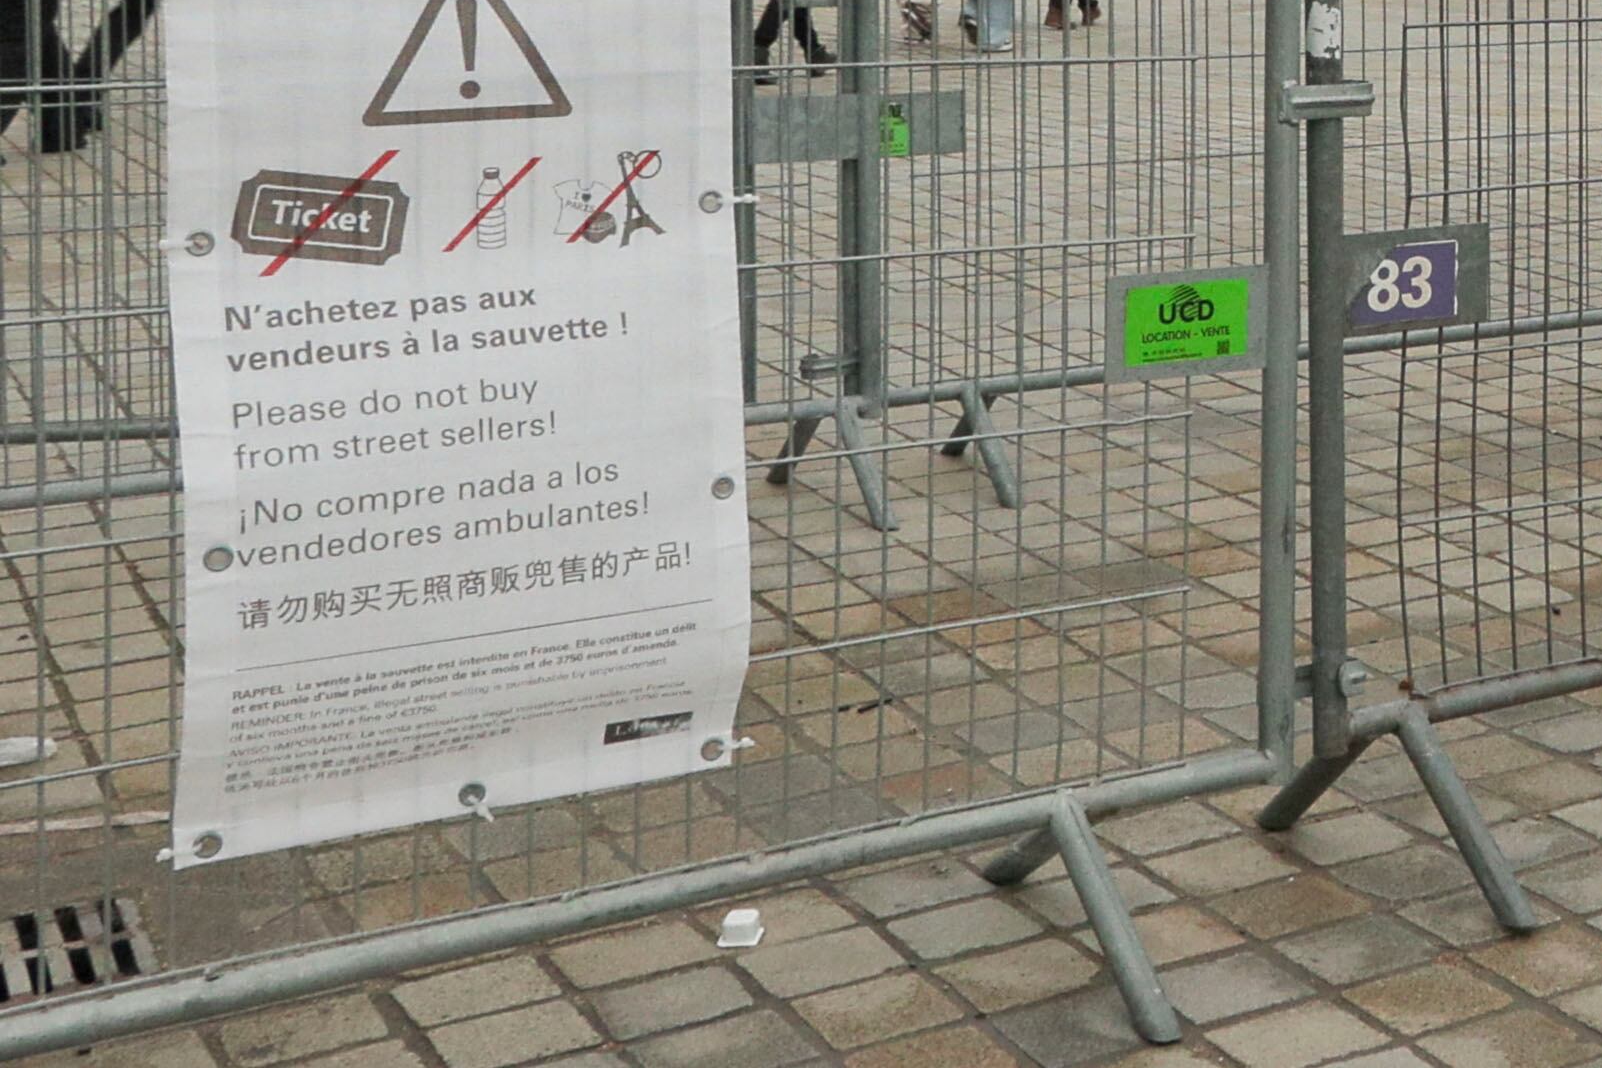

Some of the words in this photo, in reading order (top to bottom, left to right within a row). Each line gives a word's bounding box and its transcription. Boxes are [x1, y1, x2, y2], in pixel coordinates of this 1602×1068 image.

[271, 198, 372, 234] Ticket
[224, 299, 399, 332] N'achetez
[409, 294, 467, 323] pas
[478, 288, 537, 311] aux
[1367, 255, 1433, 313] 83
[1142, 330, 1191, 344] LOCATION
[1200, 326, 1230, 338] VENTE
[1158, 298, 1215, 325] UCD
[226, 339, 391, 373] vendeurs
[402, 330, 420, 357] à
[431, 328, 460, 353] la
[471, 317, 608, 350] sauvette
[620, 311, 628, 335] !
[232, 399, 346, 429] Please
[359, 389, 401, 416] do
[415, 383, 469, 410] not
[479, 378, 538, 405] buy
[233, 443, 319, 470] from
[333, 427, 430, 460] street
[440, 410, 555, 448] sellers!
[239, 497, 303, 535] ¡No
[316, 485, 445, 518] compre
[458, 469, 535, 501] nada
[546, 470, 563, 490] a
[575, 461, 619, 486] los
[236, 525, 442, 568] vendedores
[453, 490, 649, 541] ambulantes!
